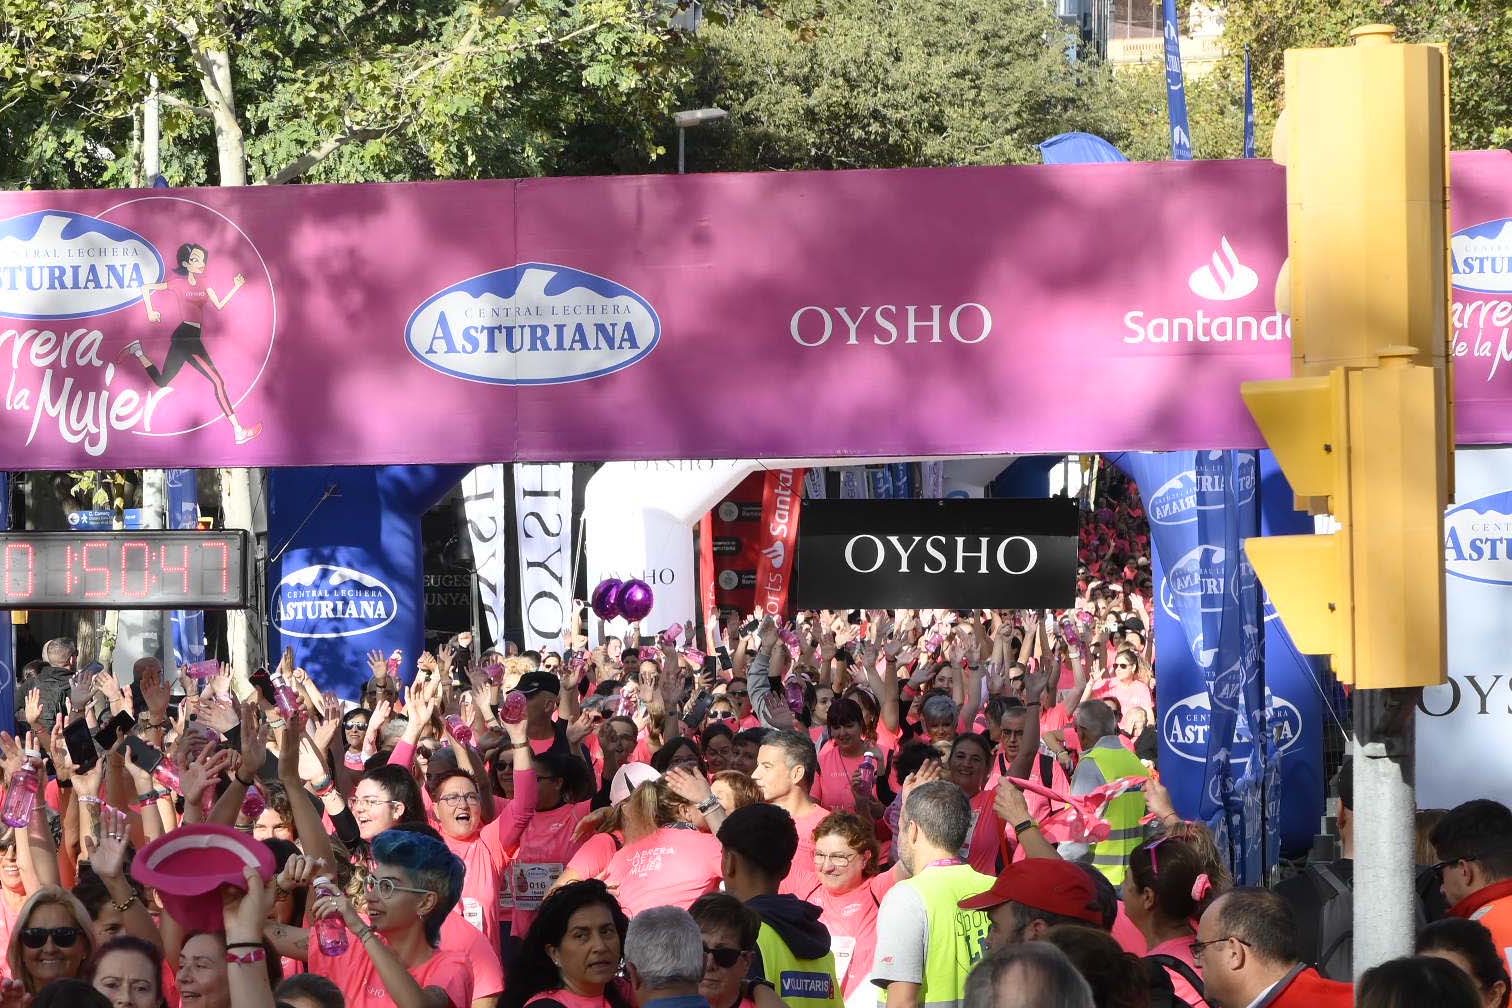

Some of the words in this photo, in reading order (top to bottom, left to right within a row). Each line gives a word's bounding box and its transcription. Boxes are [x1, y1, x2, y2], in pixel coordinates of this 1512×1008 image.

[67, 247, 140, 258] LECHERA
[465, 304, 543, 318] CENTRAL
[551, 303, 632, 316] LECHERA
[790, 302, 993, 347] OYSHO
[425, 311, 641, 355] ASTURIANA
[1123, 310, 1291, 344] Santand
[1474, 329, 1492, 357] la
[5, 372, 31, 411] la
[26, 364, 175, 457] Mujer
[844, 534, 1038, 575] OYSHO
[287, 588, 330, 599] CENTRAL
[333, 588, 383, 598] LECHERA
[275, 597, 388, 623] ASTURIANA
